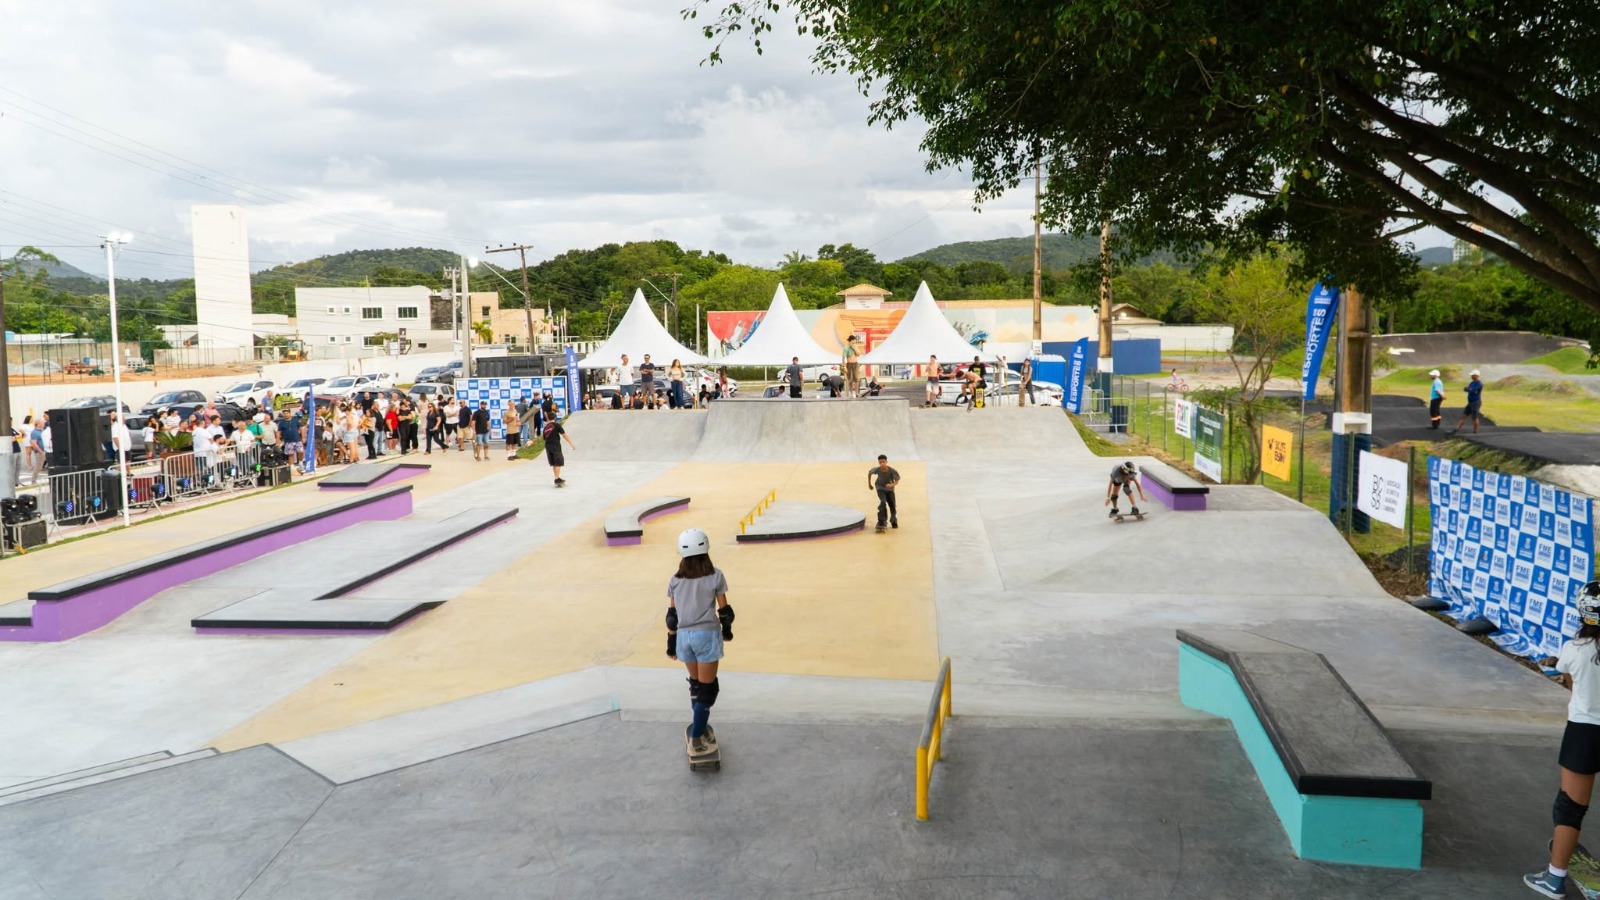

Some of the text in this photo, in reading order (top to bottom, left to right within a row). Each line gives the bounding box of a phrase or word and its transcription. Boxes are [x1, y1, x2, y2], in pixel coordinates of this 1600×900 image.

[1303, 309, 1326, 377] ESPORTES
[1513, 480, 1524, 489] FME
[1542, 488, 1553, 497] FME
[1572, 497, 1585, 507] FME
[1497, 503, 1508, 512] FME
[1525, 511, 1538, 521] FME
[1557, 521, 1569, 530] FME
[1464, 546, 1477, 555] FME
[1539, 543, 1552, 553] FME
[1573, 555, 1586, 565] FME
[1515, 565, 1531, 575] FME
[1552, 578, 1566, 588] FME
[1529, 598, 1544, 609] FME
[1566, 612, 1581, 623] FME
[1545, 633, 1560, 643] FME
